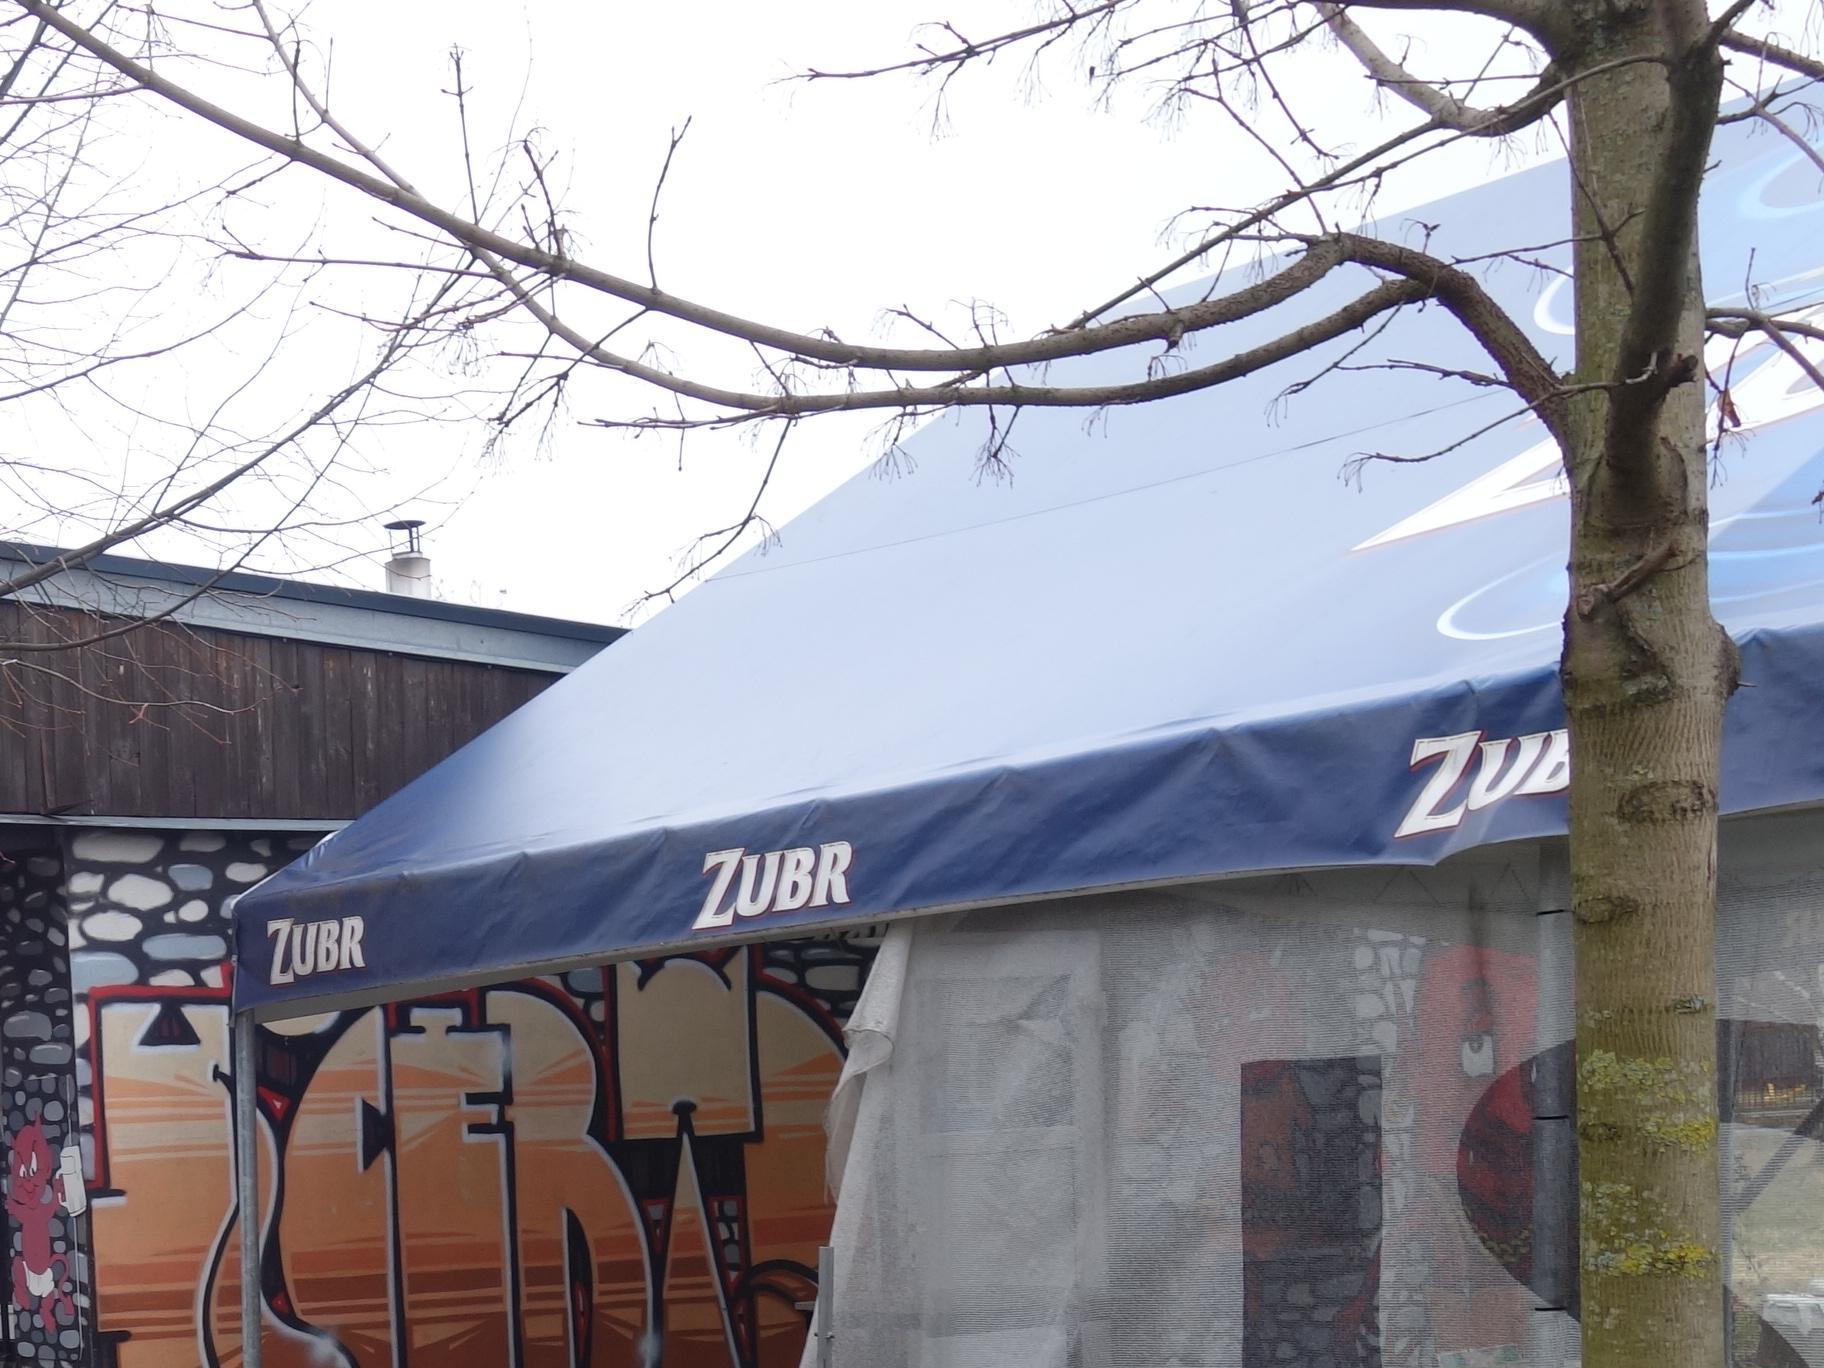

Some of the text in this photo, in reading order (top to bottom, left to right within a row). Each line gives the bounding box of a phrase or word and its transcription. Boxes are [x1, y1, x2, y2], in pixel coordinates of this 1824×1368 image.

[1393, 729, 1571, 841] ZUB
[690, 840, 854, 931] ZUBR
[266, 915, 367, 988] ZUBR
